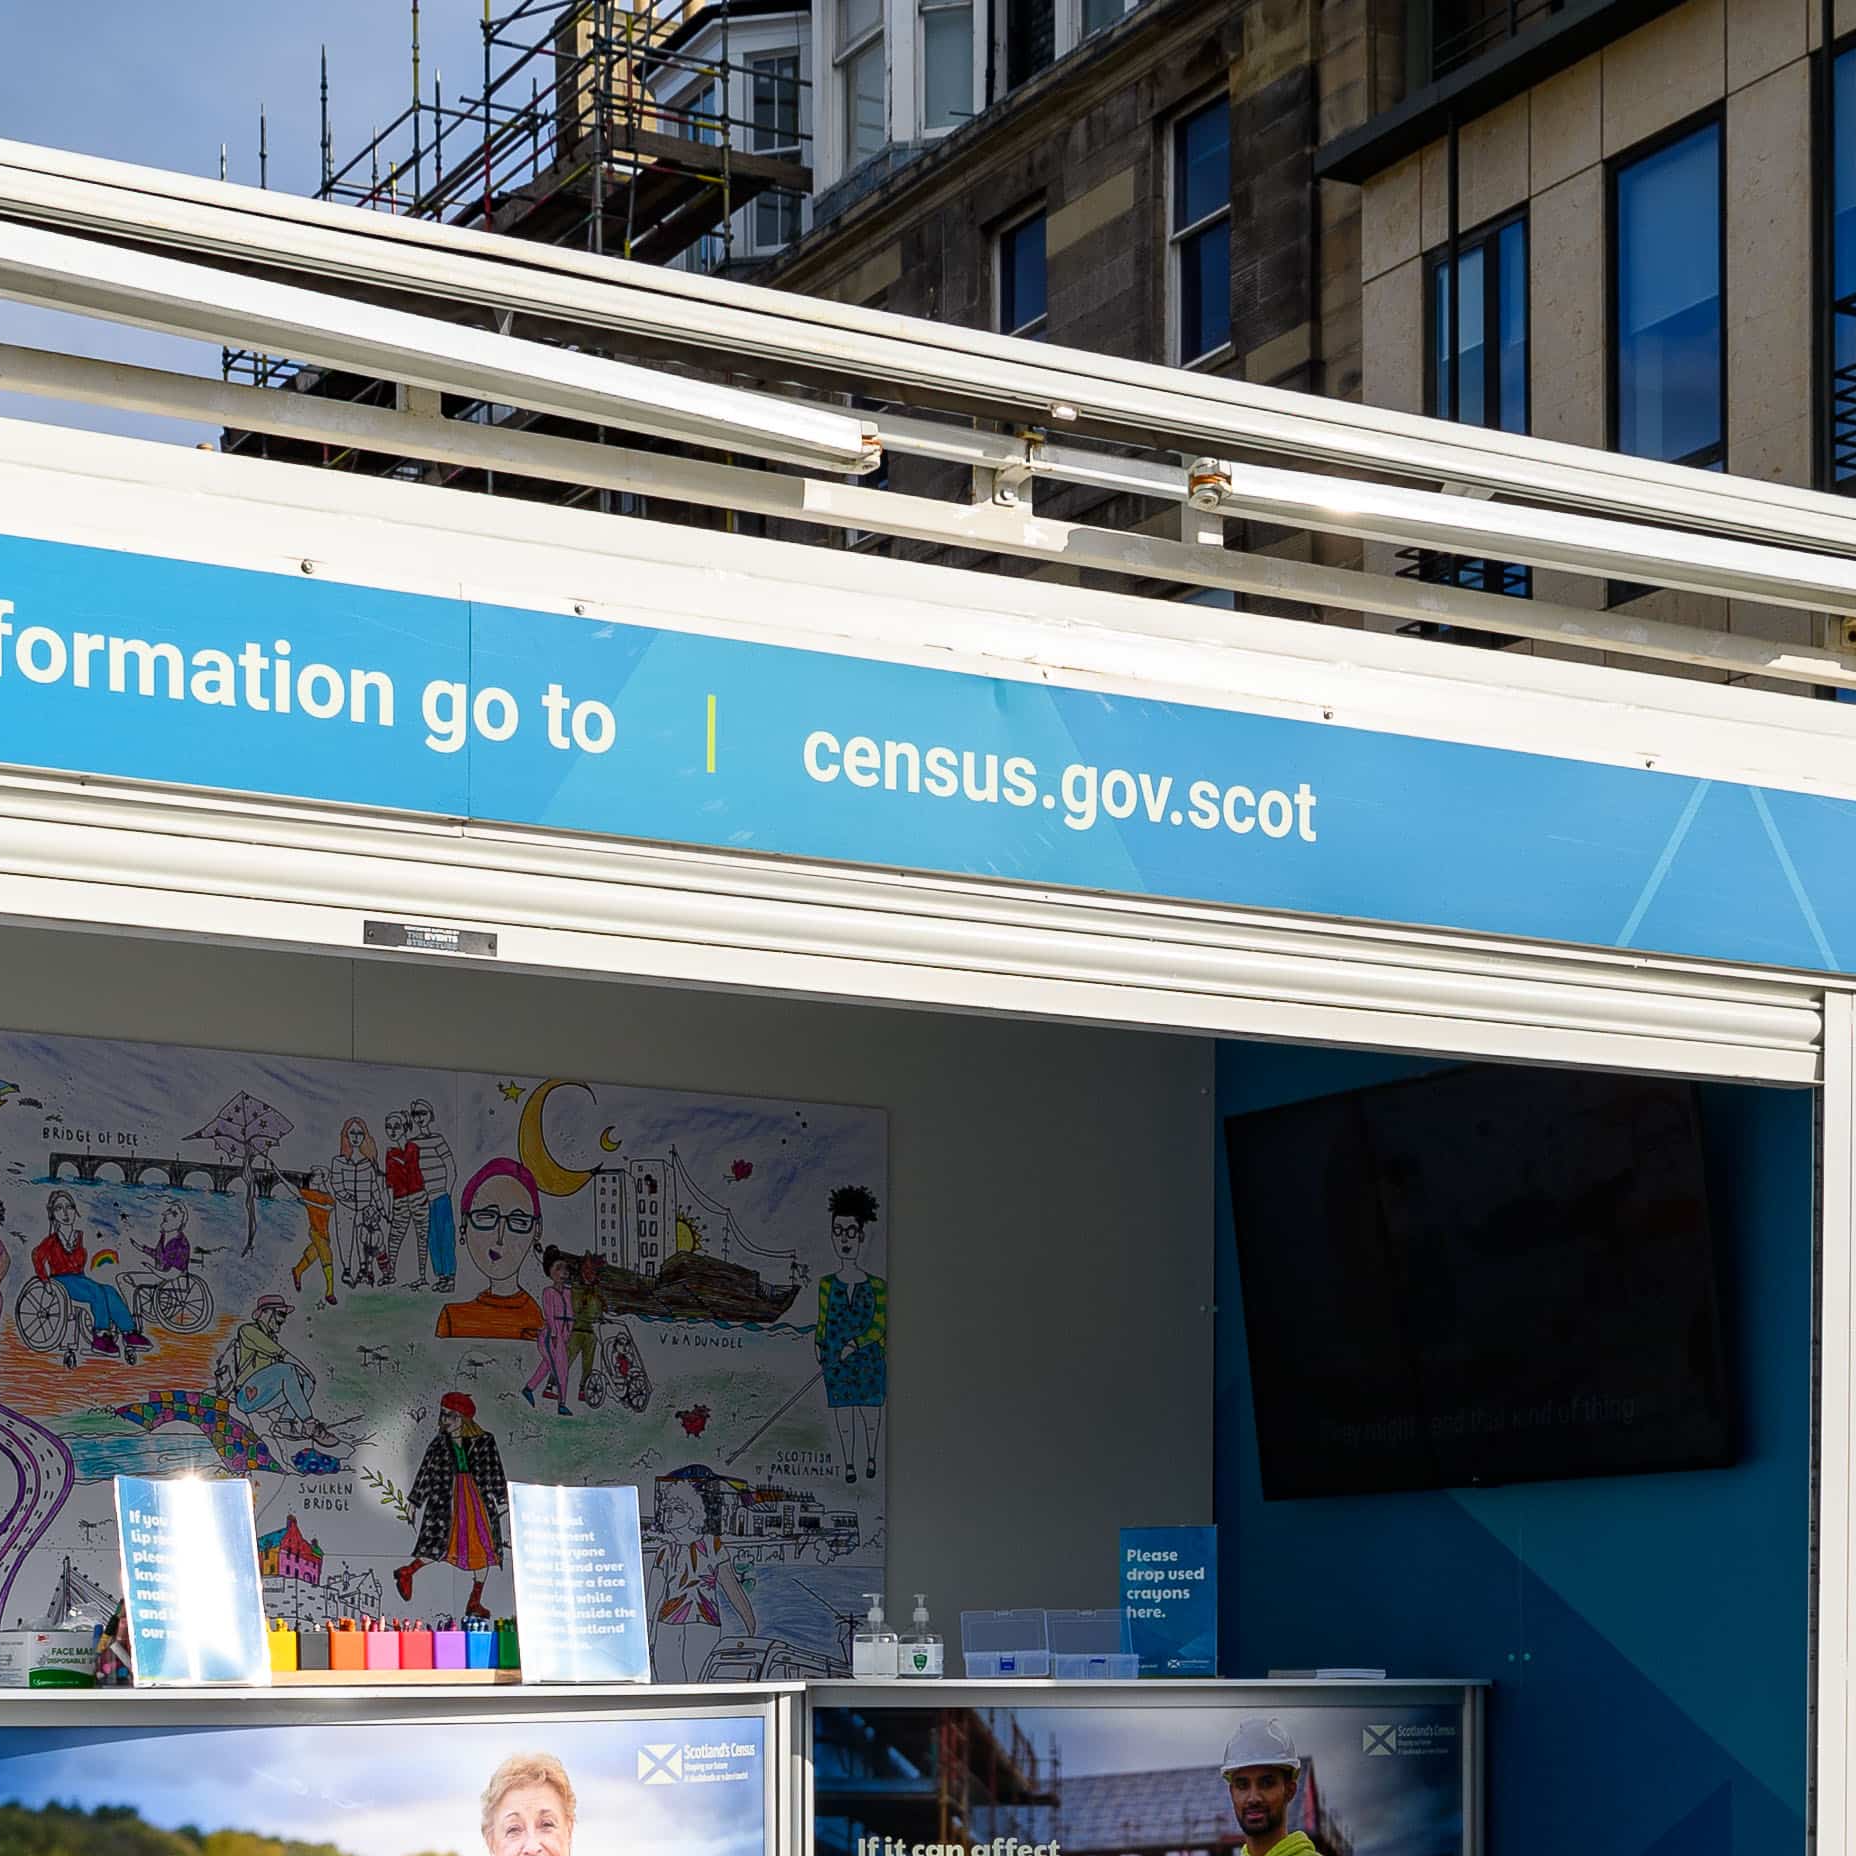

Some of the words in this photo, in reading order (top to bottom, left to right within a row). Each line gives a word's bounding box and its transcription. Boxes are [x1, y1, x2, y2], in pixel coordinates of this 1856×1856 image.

[421, 680, 519, 753] go
[540, 684, 616, 754] to
[803, 730, 1317, 842] census.gov.scot
[43, 1127, 91, 1143] BRIDGE
[117, 1132, 138, 1146] DEE
[776, 1450, 832, 1463] SCOTTISH
[770, 1463, 841, 1477] PARLIAMENT
[298, 1482, 353, 1495] SWILKEN
[304, 1497, 350, 1511] BRIDGE
[1127, 1549, 1178, 1562] Please
[1126, 1568, 1165, 1583] drop
[1167, 1567, 1205, 1580] used
[1126, 1588, 1190, 1603] crayons
[1126, 1605, 1166, 1618] here.
